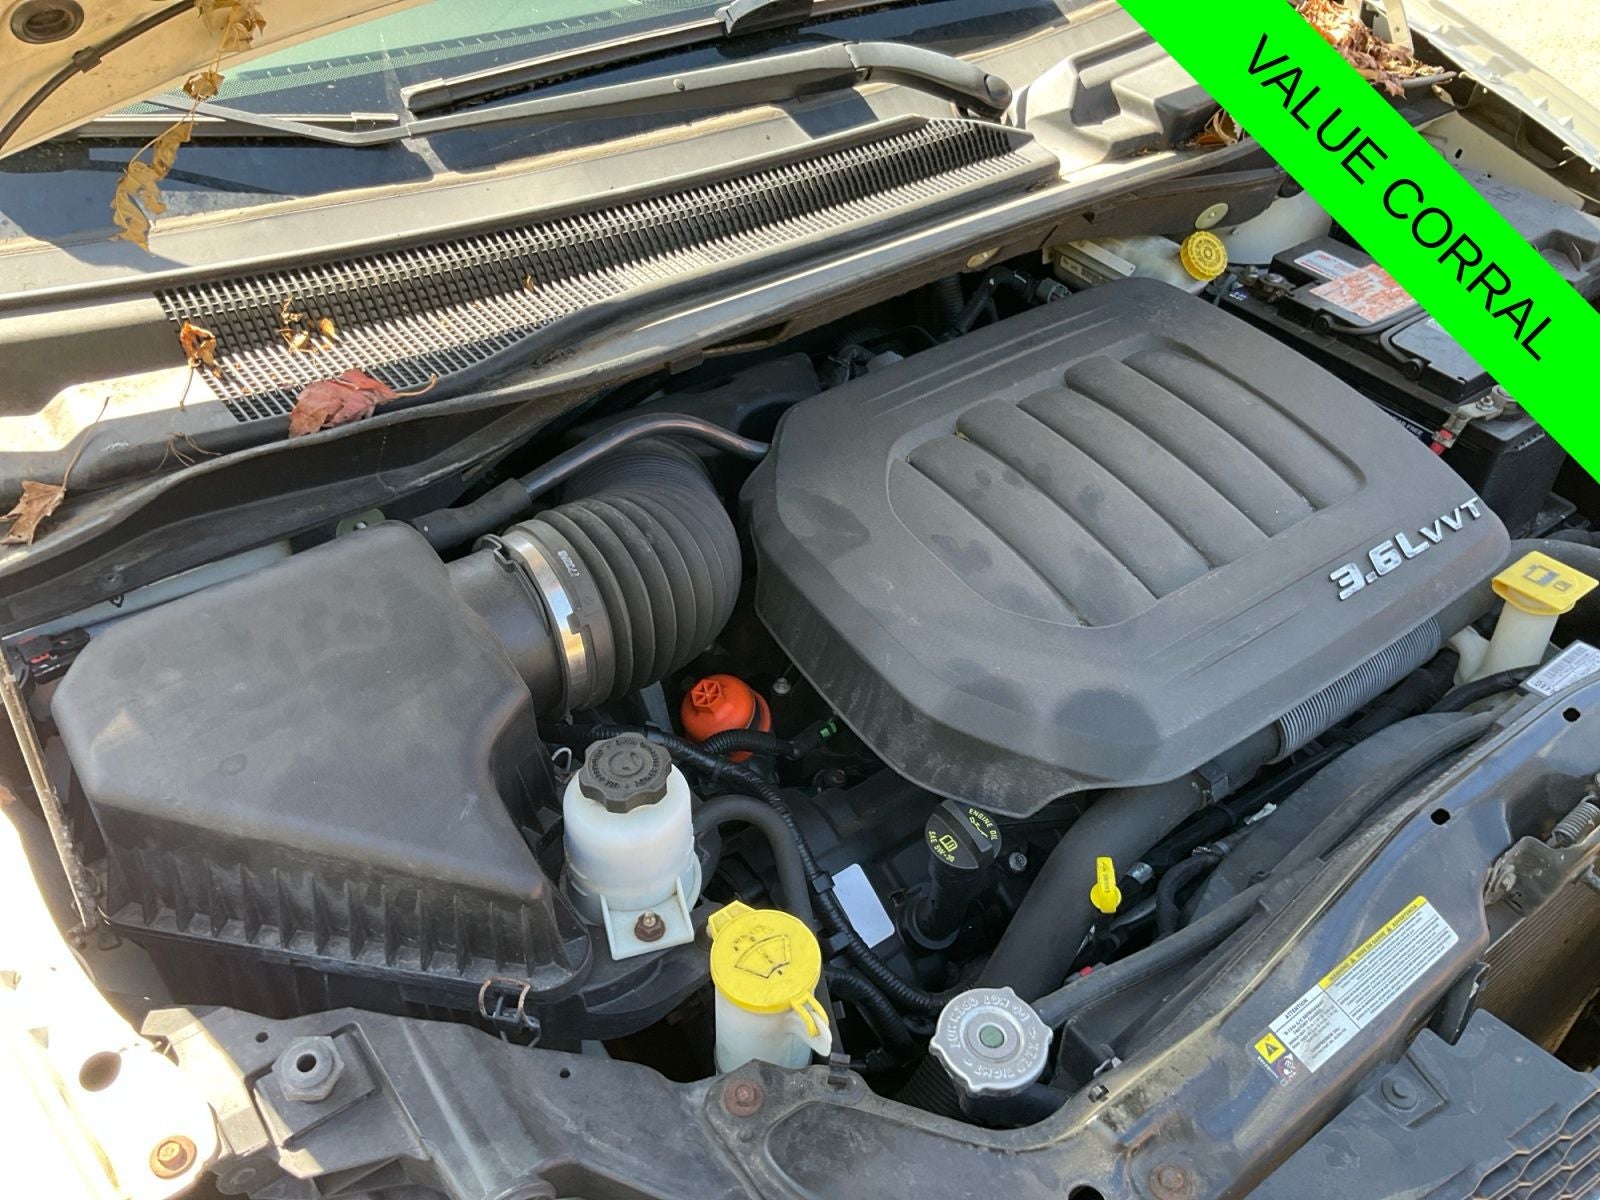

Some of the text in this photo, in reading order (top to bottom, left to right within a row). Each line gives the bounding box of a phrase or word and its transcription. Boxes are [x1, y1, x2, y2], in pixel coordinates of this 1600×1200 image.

[968, 808, 998, 840] ENGINE OIL
[928, 830, 939, 844] SAE
[1285, 998, 1308, 1019] ATTENTION
